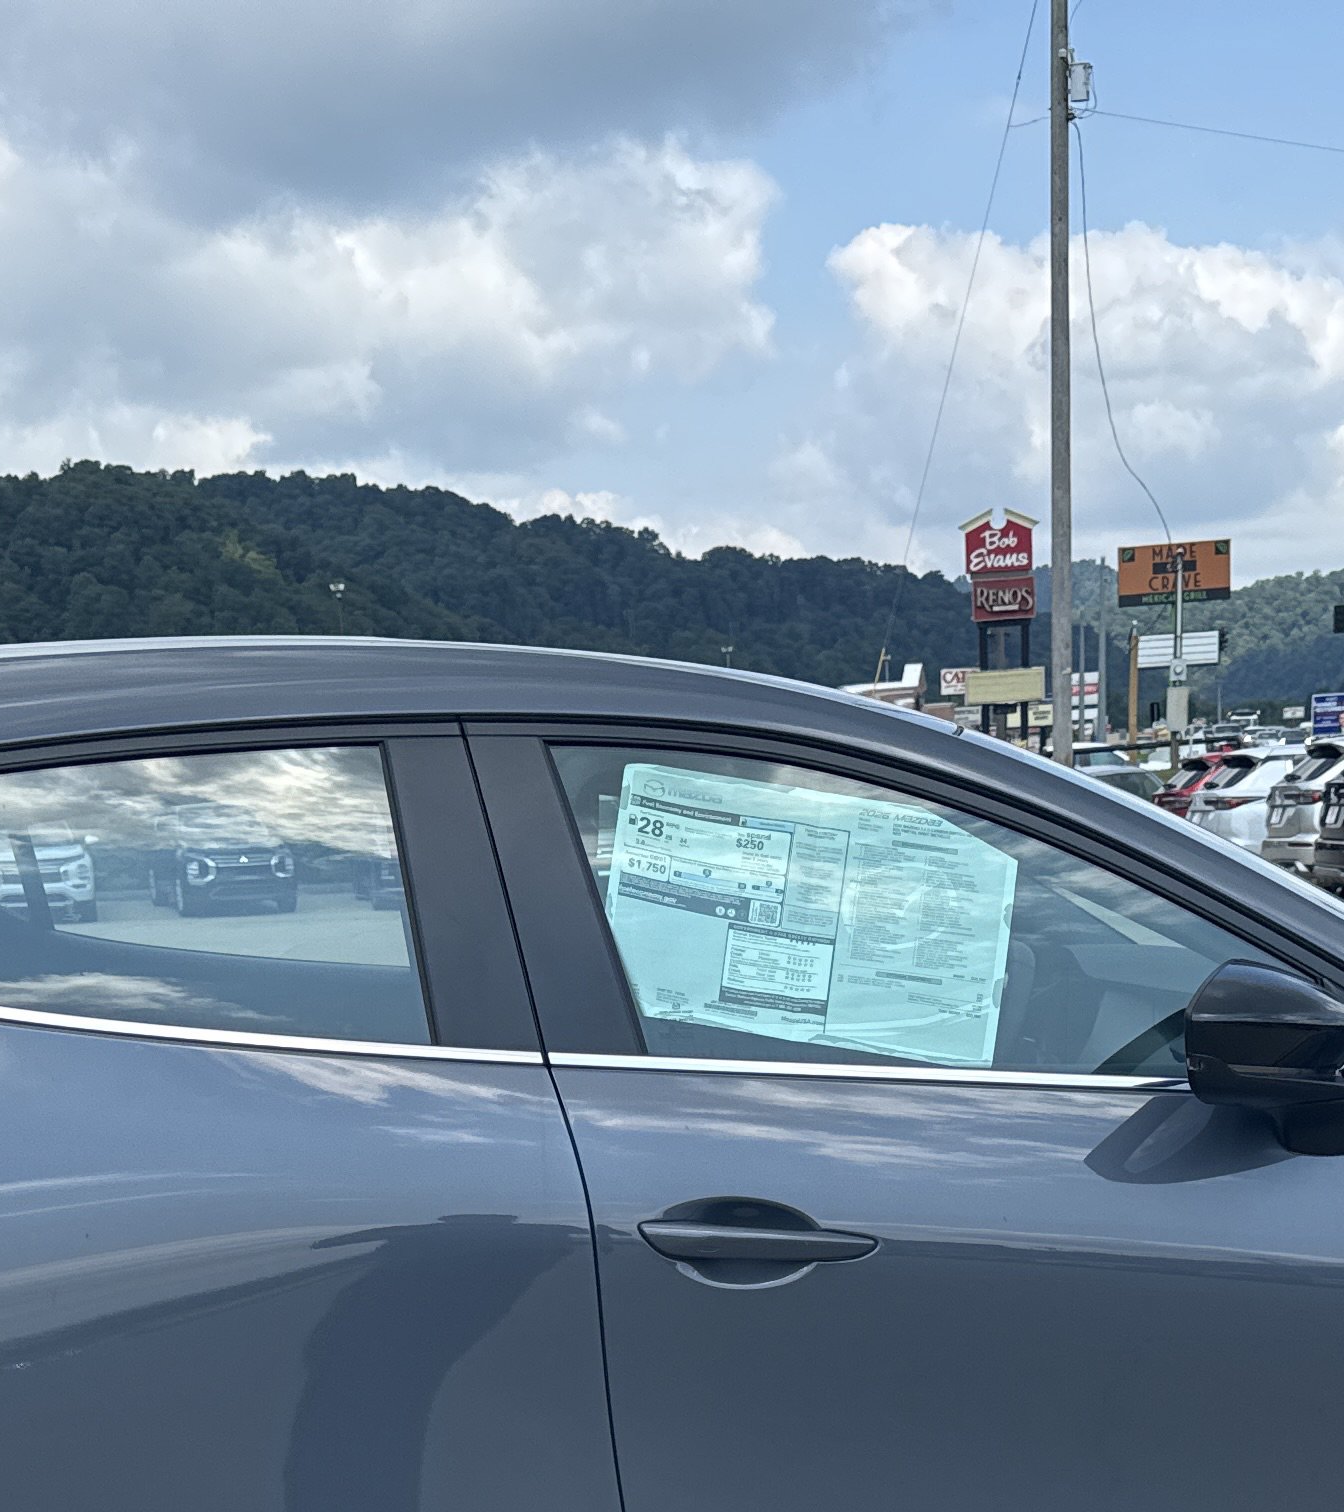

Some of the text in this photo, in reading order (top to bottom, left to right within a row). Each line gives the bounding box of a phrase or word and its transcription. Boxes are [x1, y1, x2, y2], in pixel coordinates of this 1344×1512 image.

[979, 530, 1018, 550] Bob
[969, 547, 1029, 571] Evans
[637, 815, 665, 838] 28
[735, 837, 764, 851] $250
